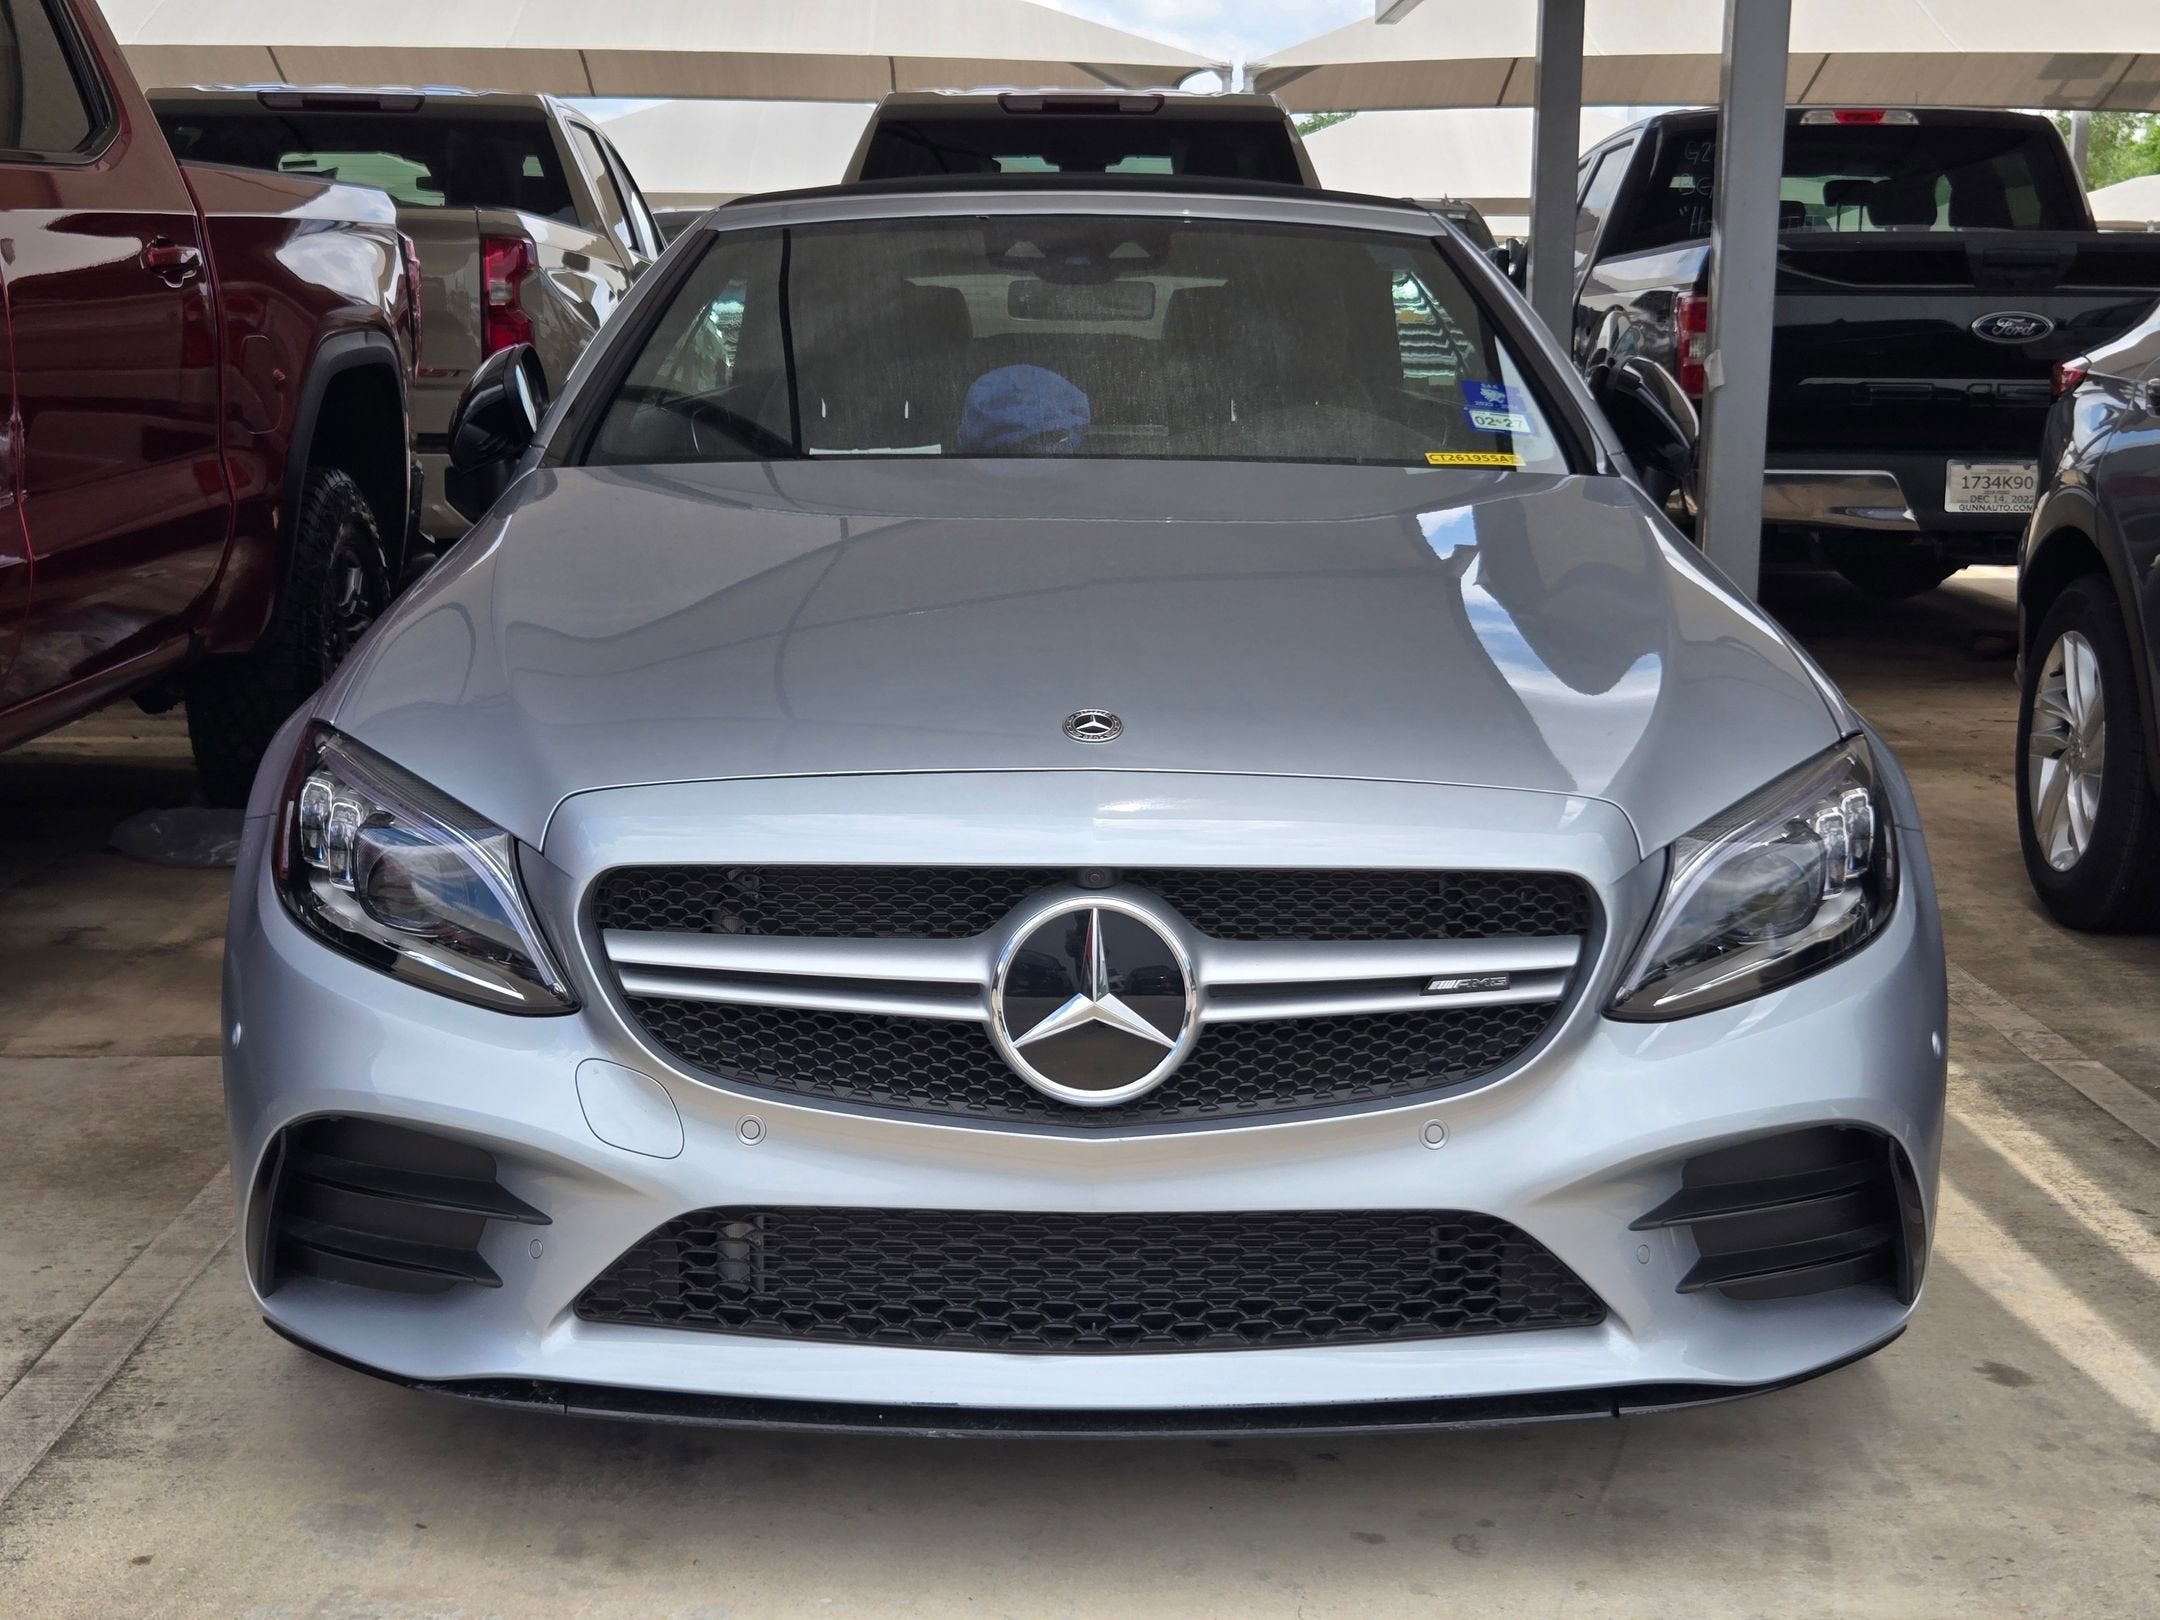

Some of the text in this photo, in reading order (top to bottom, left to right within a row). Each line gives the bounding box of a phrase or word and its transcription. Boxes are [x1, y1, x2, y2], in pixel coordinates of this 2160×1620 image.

[1991, 317, 2036, 336] Ford
[1961, 475, 2034, 490] 1734K90
[1970, 494, 1990, 504] DEC
[1958, 504, 2033, 512] GUNNAUTO.COM
